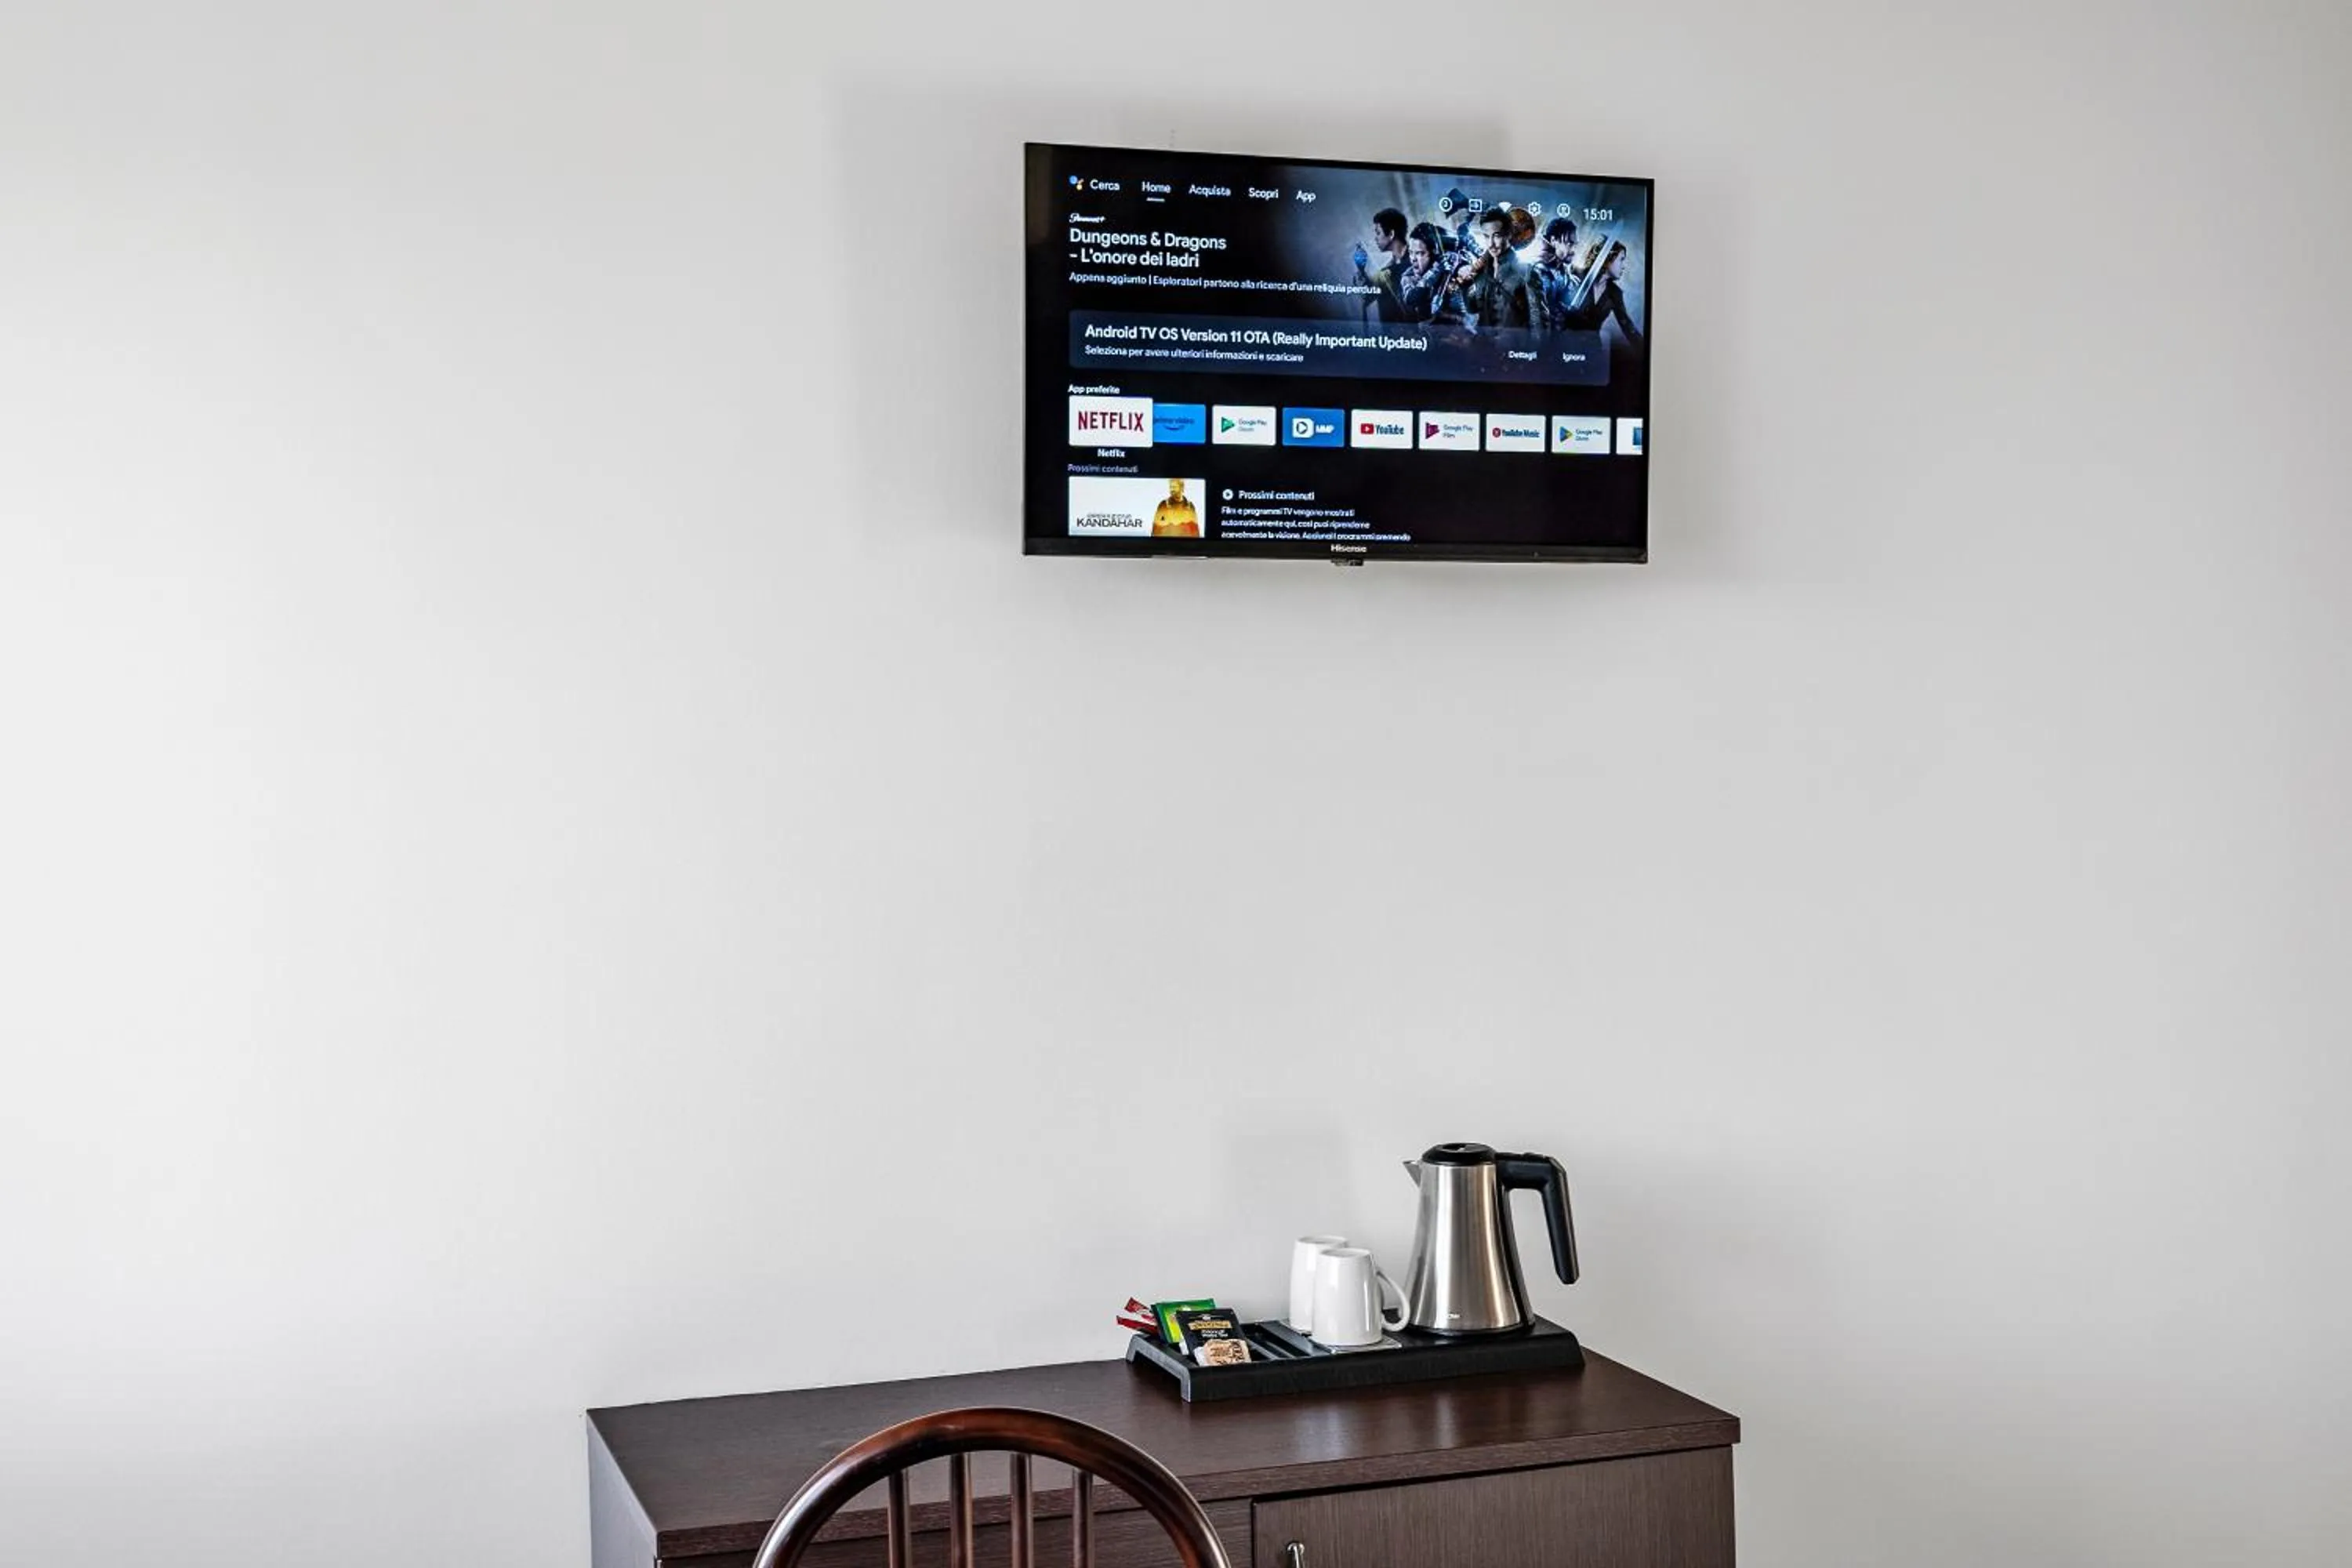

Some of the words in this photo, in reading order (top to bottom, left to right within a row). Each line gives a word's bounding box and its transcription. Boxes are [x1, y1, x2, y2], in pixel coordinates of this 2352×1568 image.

[1090, 179, 1120, 191] Cerca
[1142, 181, 1171, 194] Home
[1189, 183, 1231, 198] Acquista
[1248, 187, 1279, 201] Scopri
[1296, 190, 1316, 203] App
[1583, 209, 1613, 221] 15:01
[1069, 228, 1147, 248] Dungeons
[1150, 231, 1161, 247] &
[1164, 233, 1227, 251] Dragons
[1080, 248, 1137, 266] L'onore
[1139, 251, 1163, 267] dei
[1166, 252, 1200, 268] ladri
[1069, 271, 1105, 283] Appena
[1106, 274, 1147, 285] aggiunto
[1153, 275, 1202, 288] Esploratori
[1203, 278, 1239, 289] partono
[1240, 279, 1255, 289] alla
[1256, 280, 1288, 291] ricerca
[1289, 281, 1312, 291] d'una
[1314, 283, 1345, 294] reliquia
[1347, 285, 1381, 295] perduta
[1085, 324, 1137, 339] Android
[1139, 326, 1156, 339] TV
[1159, 327, 1178, 340] OS
[1180, 328, 1228, 343] Version
[1230, 330, 1241, 343] 11
[1243, 330, 1270, 344] OTA
[1272, 331, 1312, 348] (Really
[1315, 333, 1376, 349] Important
[1378, 336, 1428, 351] Update)
[1085, 345, 1127, 356] Seleziona
[1128, 349, 1143, 358] per
[1145, 349, 1169, 358] avere
[1171, 347, 1205, 358] ulteriori
[1206, 349, 1258, 360] informazioni
[1266, 352, 1304, 362] scaricare
[1068, 384, 1085, 394] App
[1086, 385, 1120, 394] preferite
[1078, 411, 1144, 432] NETFLIX
[1375, 424, 1405, 435] YouTube
[1523, 429, 1541, 437] Music
[1097, 448, 1125, 458] Netflix
[1068, 463, 1100, 473] Prossimi
[1102, 464, 1138, 474] contenuti
[1239, 490, 1274, 500] Prossimi
[1276, 491, 1315, 501] contenuti
[1243, 507, 1283, 517] programmi
[1076, 517, 1142, 528] KANDAHAR
[1221, 518, 1283, 528] automaticamente
